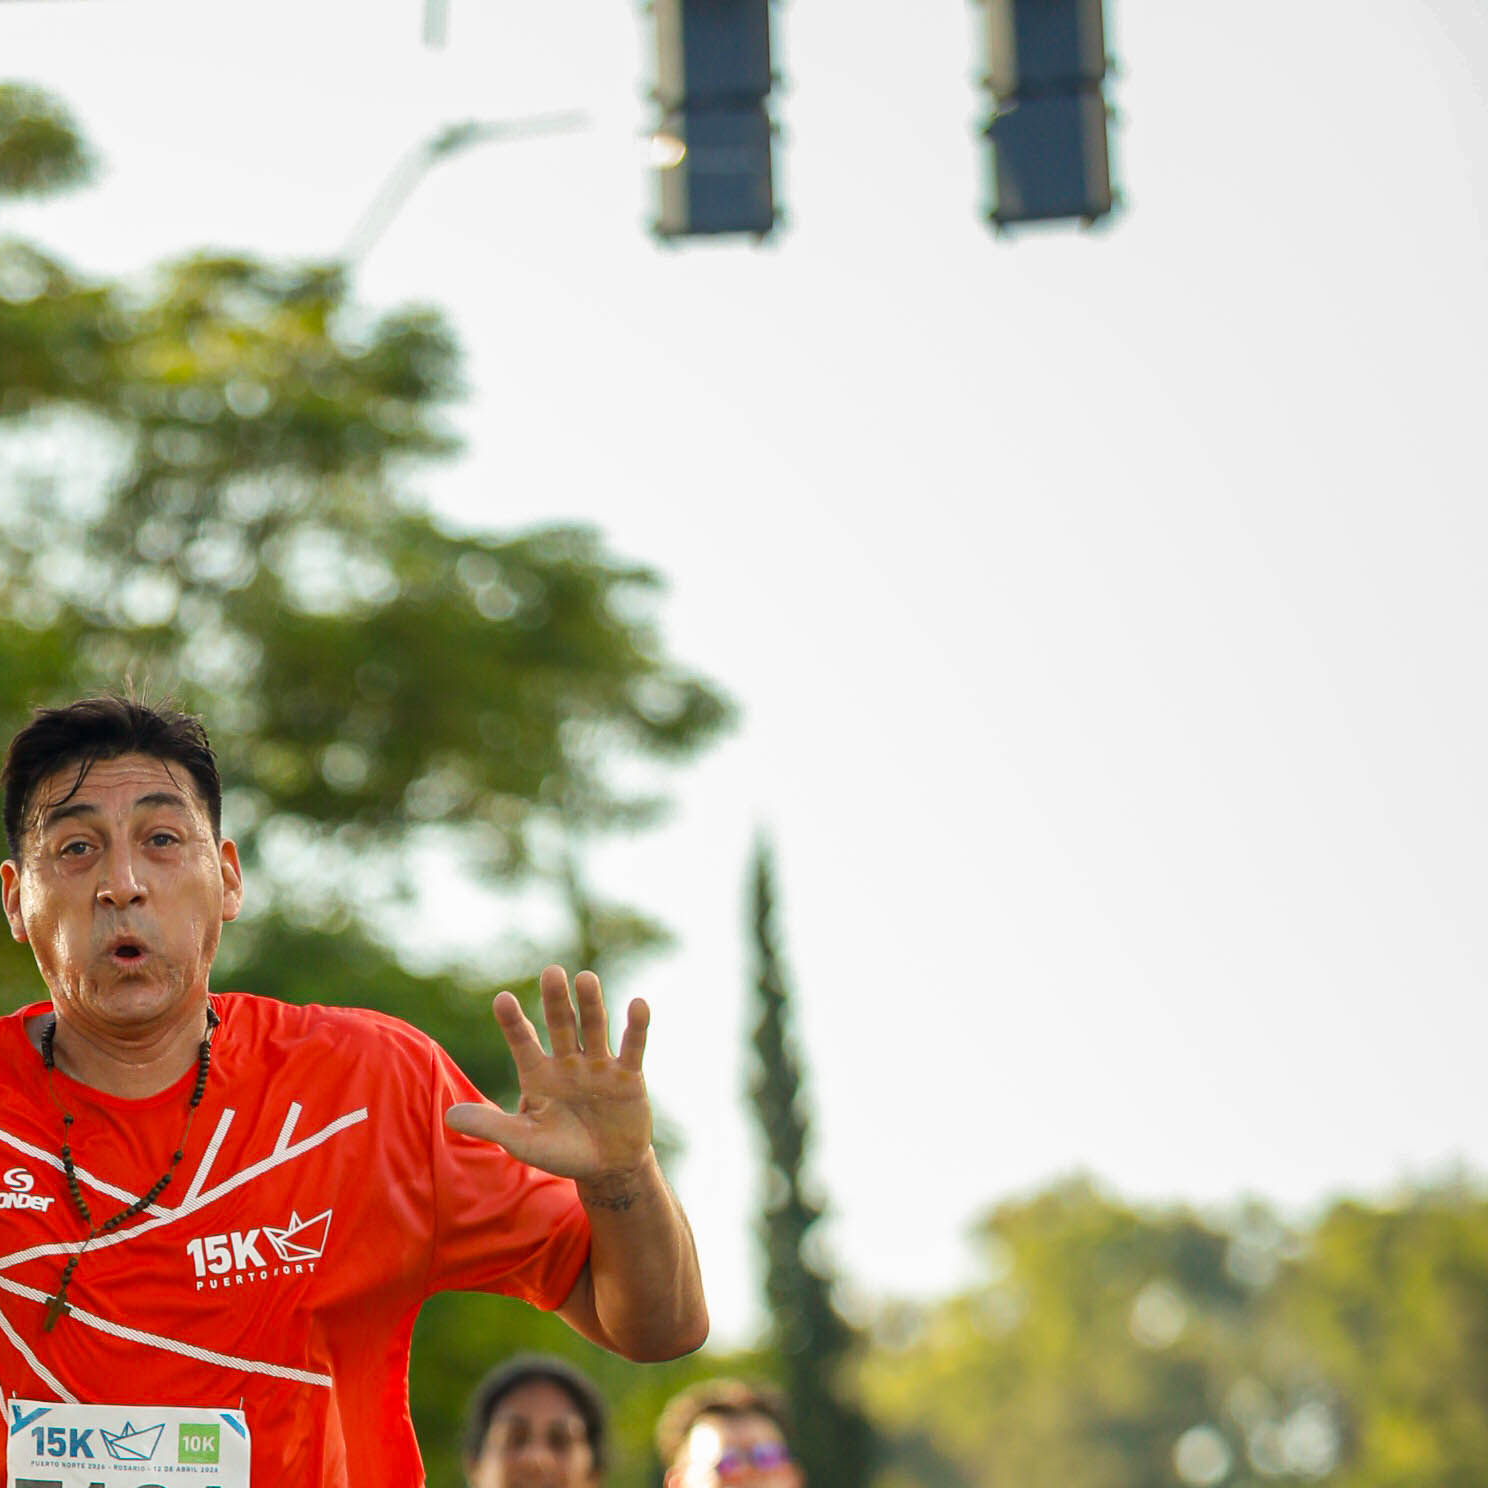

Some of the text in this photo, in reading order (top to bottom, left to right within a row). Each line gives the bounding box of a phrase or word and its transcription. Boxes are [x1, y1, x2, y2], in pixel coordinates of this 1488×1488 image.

[186, 1229, 267, 1277] 15K
[196, 1271, 268, 1291] PUERTO
[31, 1426, 96, 1459] 15K
[182, 1435, 216, 1453] 10K
[30, 1460, 59, 1468] PUERTO
[61, 1461, 86, 1469] NORTE
